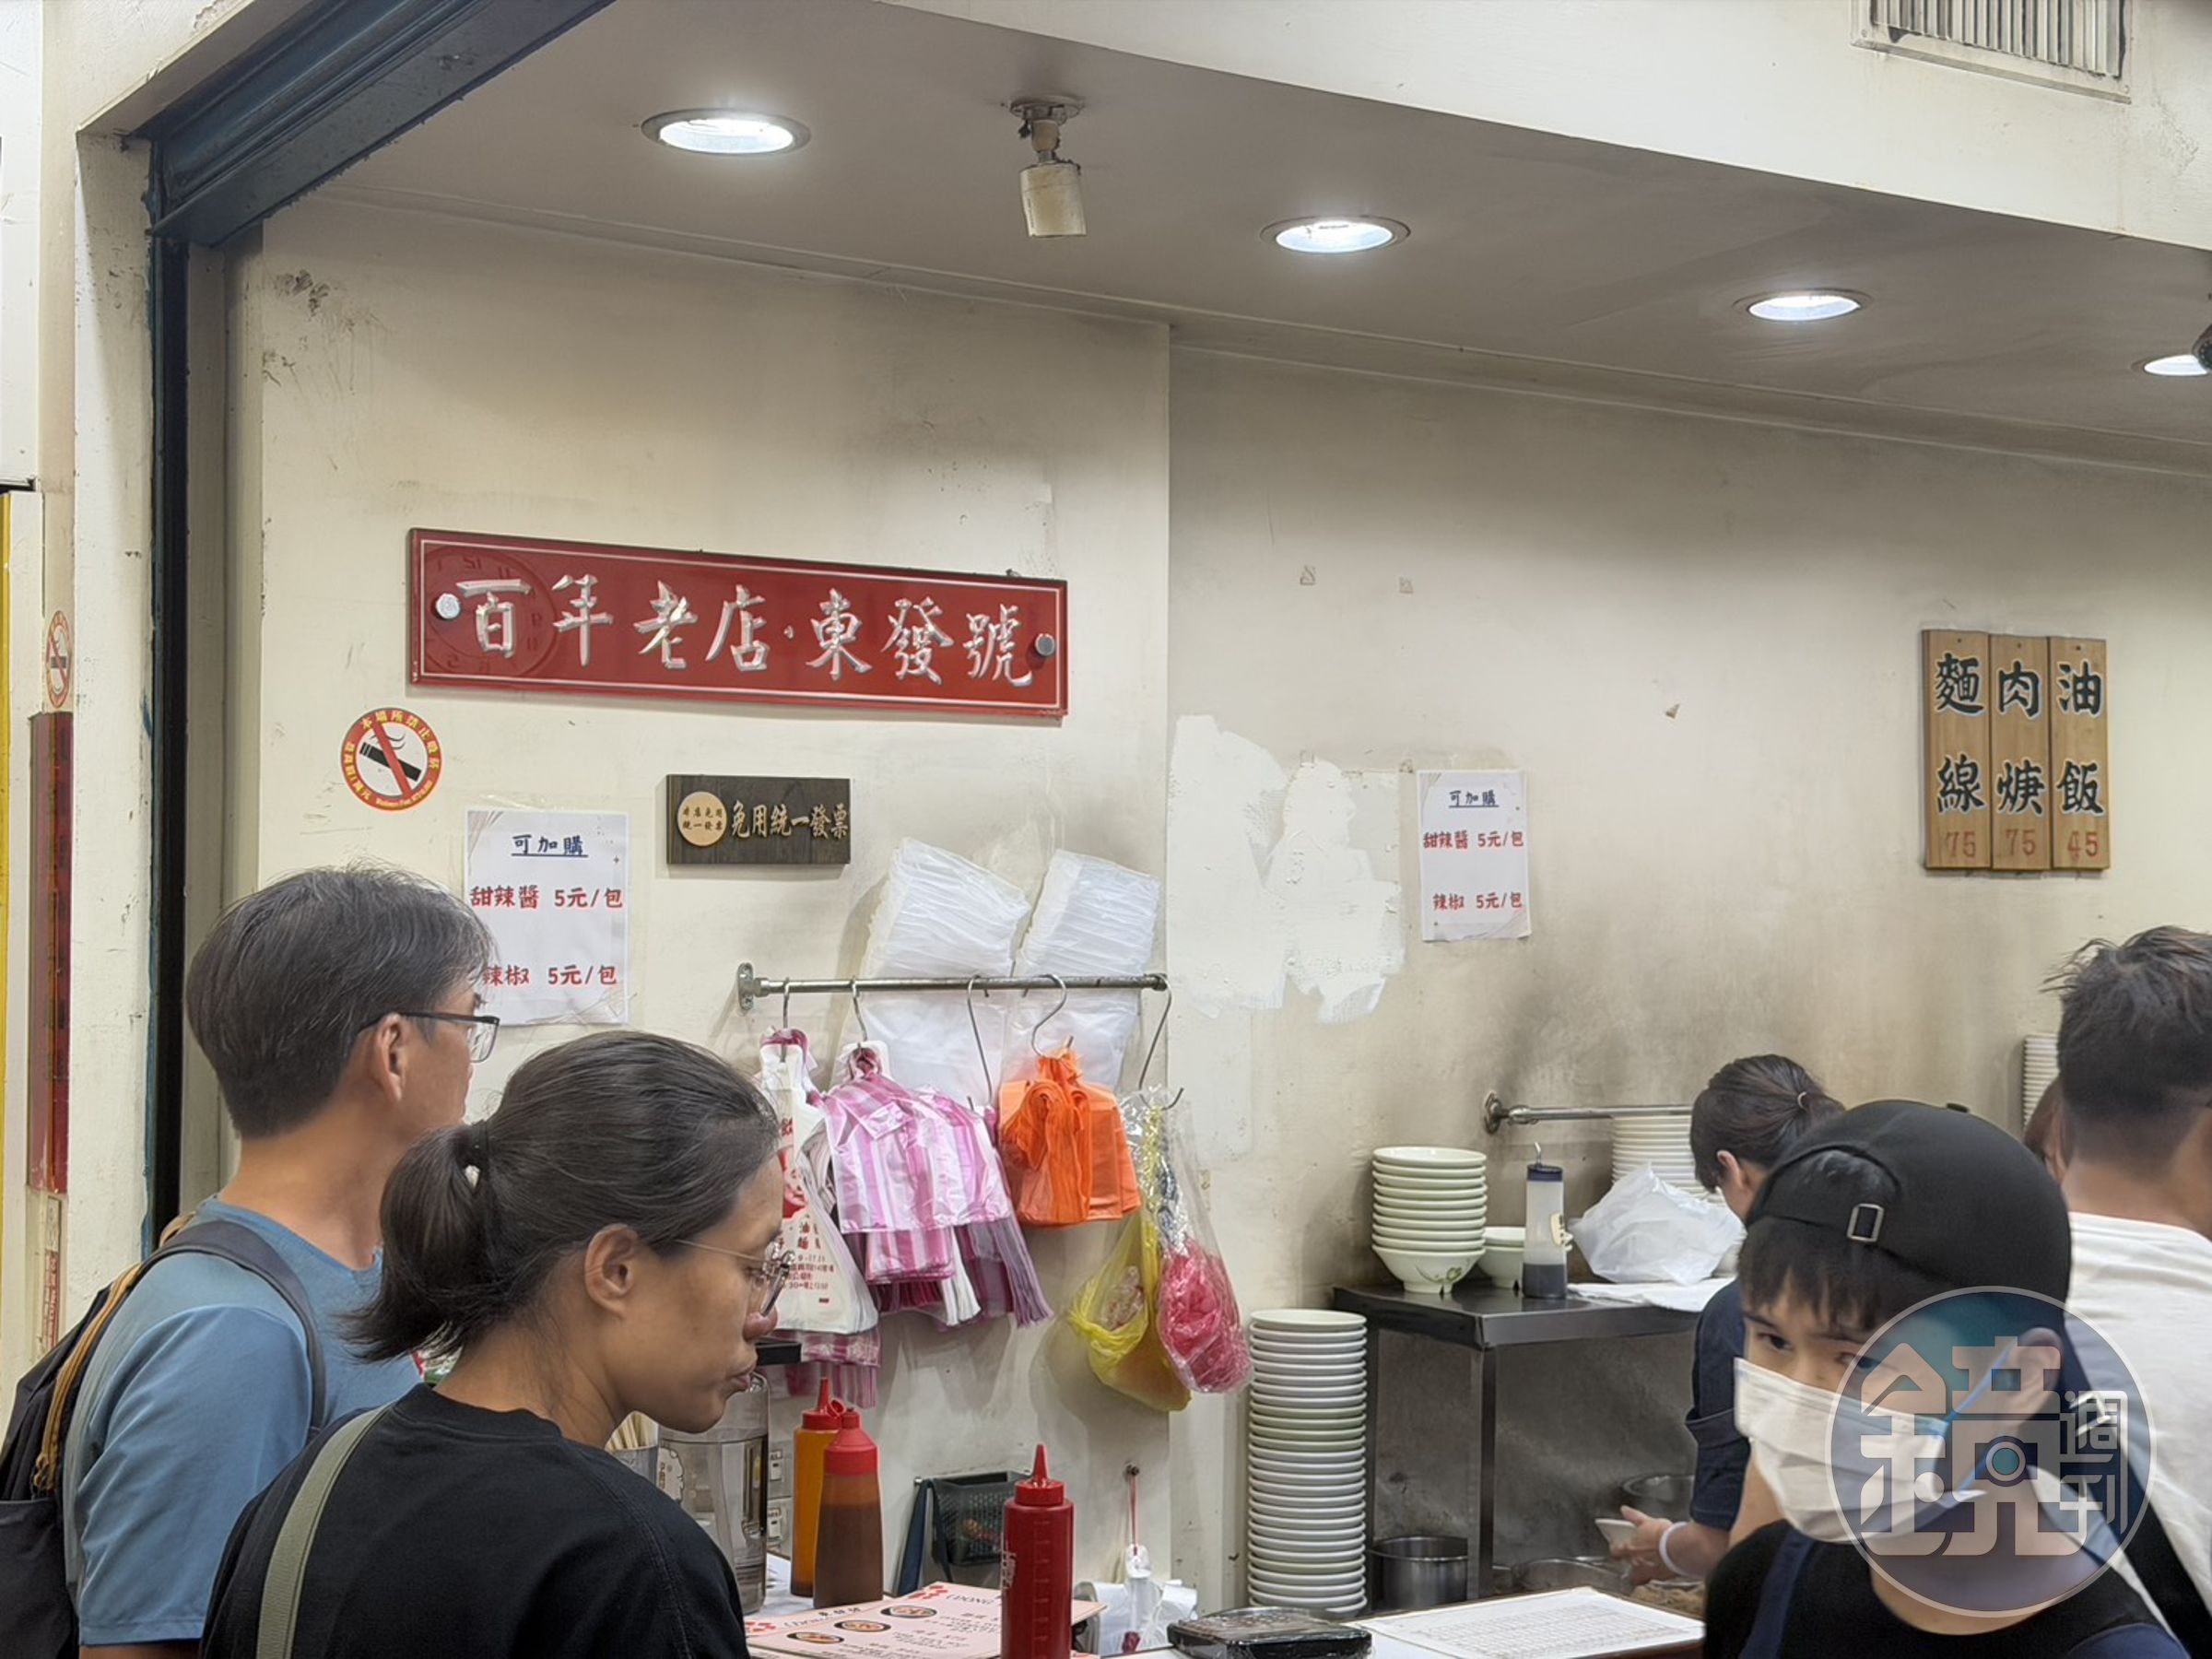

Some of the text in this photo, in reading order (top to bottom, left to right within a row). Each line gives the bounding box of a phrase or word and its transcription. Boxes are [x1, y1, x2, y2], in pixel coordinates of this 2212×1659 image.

[1936, 652, 1984, 813] 麵線
[2057, 661, 2103, 814] 油飯
[1450, 790, 1497, 806] 可加購
[731, 799, 849, 840] 免用統一發票
[513, 833, 584, 855] 可加購
[1423, 830, 1524, 849] 甜辣醬 5元/包
[1945, 830, 1976, 858] 75
[2006, 829, 2036, 856] 75
[2066, 830, 2099, 858] 45
[470, 884, 623, 909] 甜辣醬 5元/包
[1433, 892, 1523, 911] 辣椒 5元/包
[548, 964, 618, 986] 5元/包
